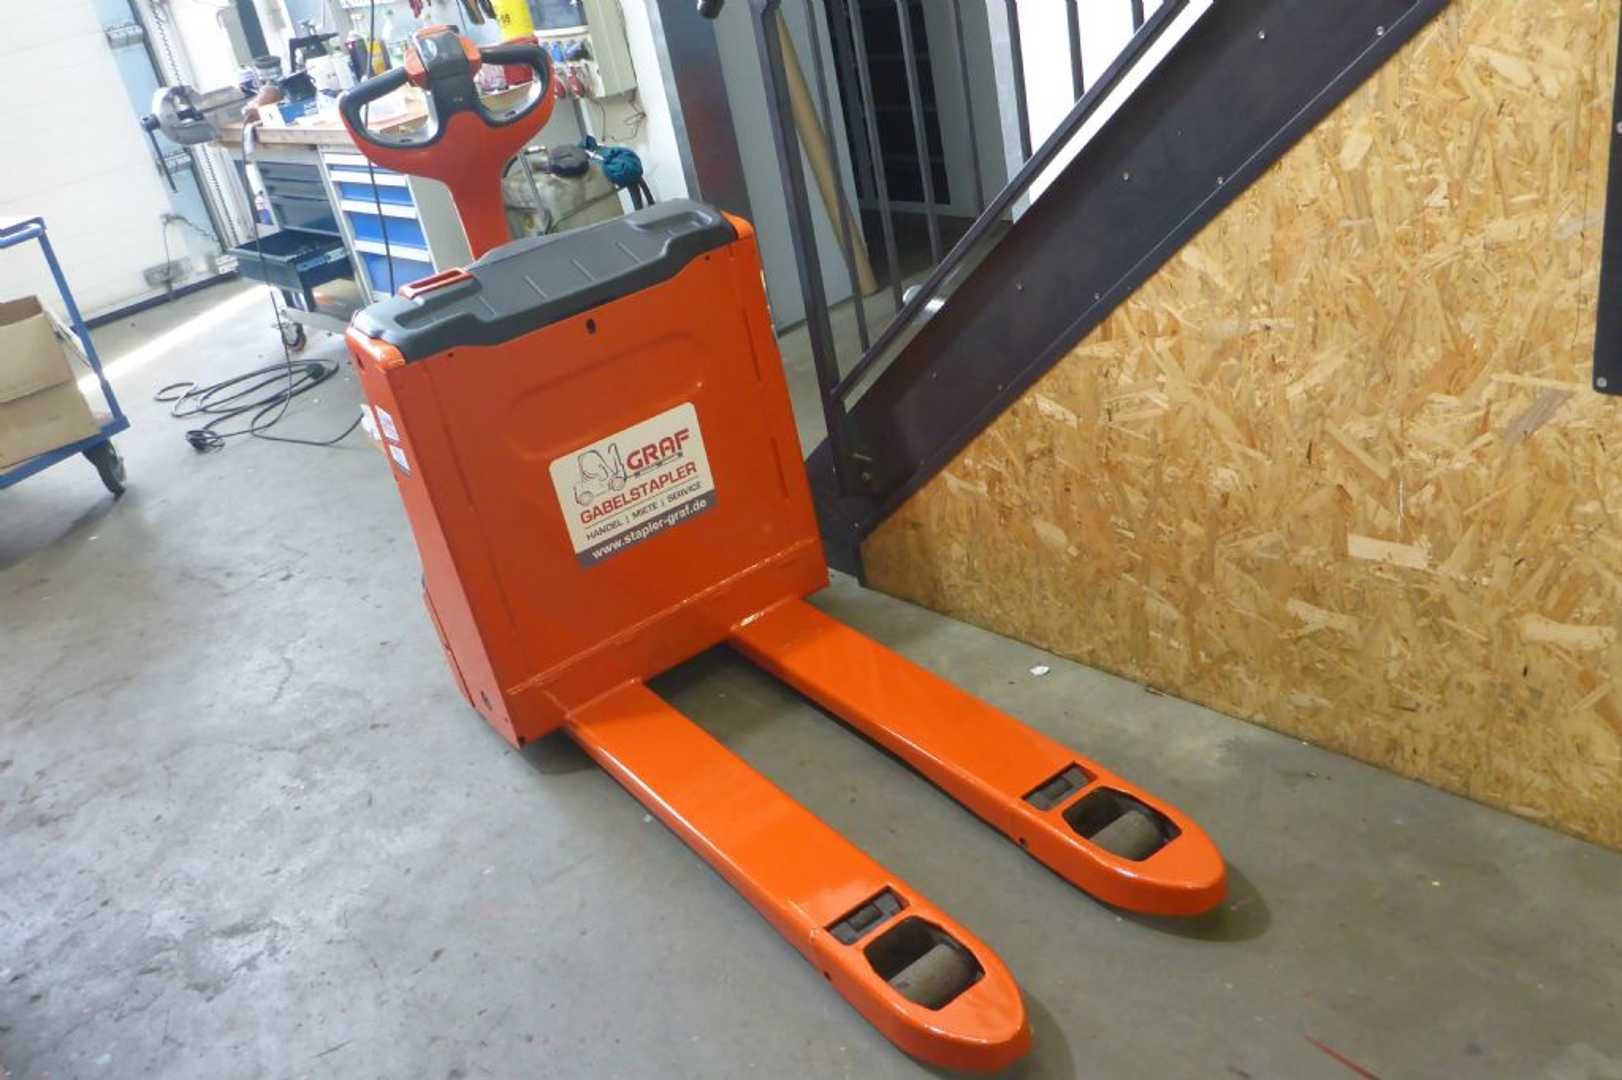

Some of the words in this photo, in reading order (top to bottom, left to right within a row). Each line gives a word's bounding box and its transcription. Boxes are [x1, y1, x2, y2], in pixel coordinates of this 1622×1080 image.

[626, 427, 690, 471] GRAF
[580, 461, 697, 524] GABELSTAPLER
[586, 520, 622, 541] HANDEL
[632, 502, 659, 518] MIETE
[667, 481, 703, 503] SERVICE
[592, 499, 708, 560] www.stapler-graf.de
